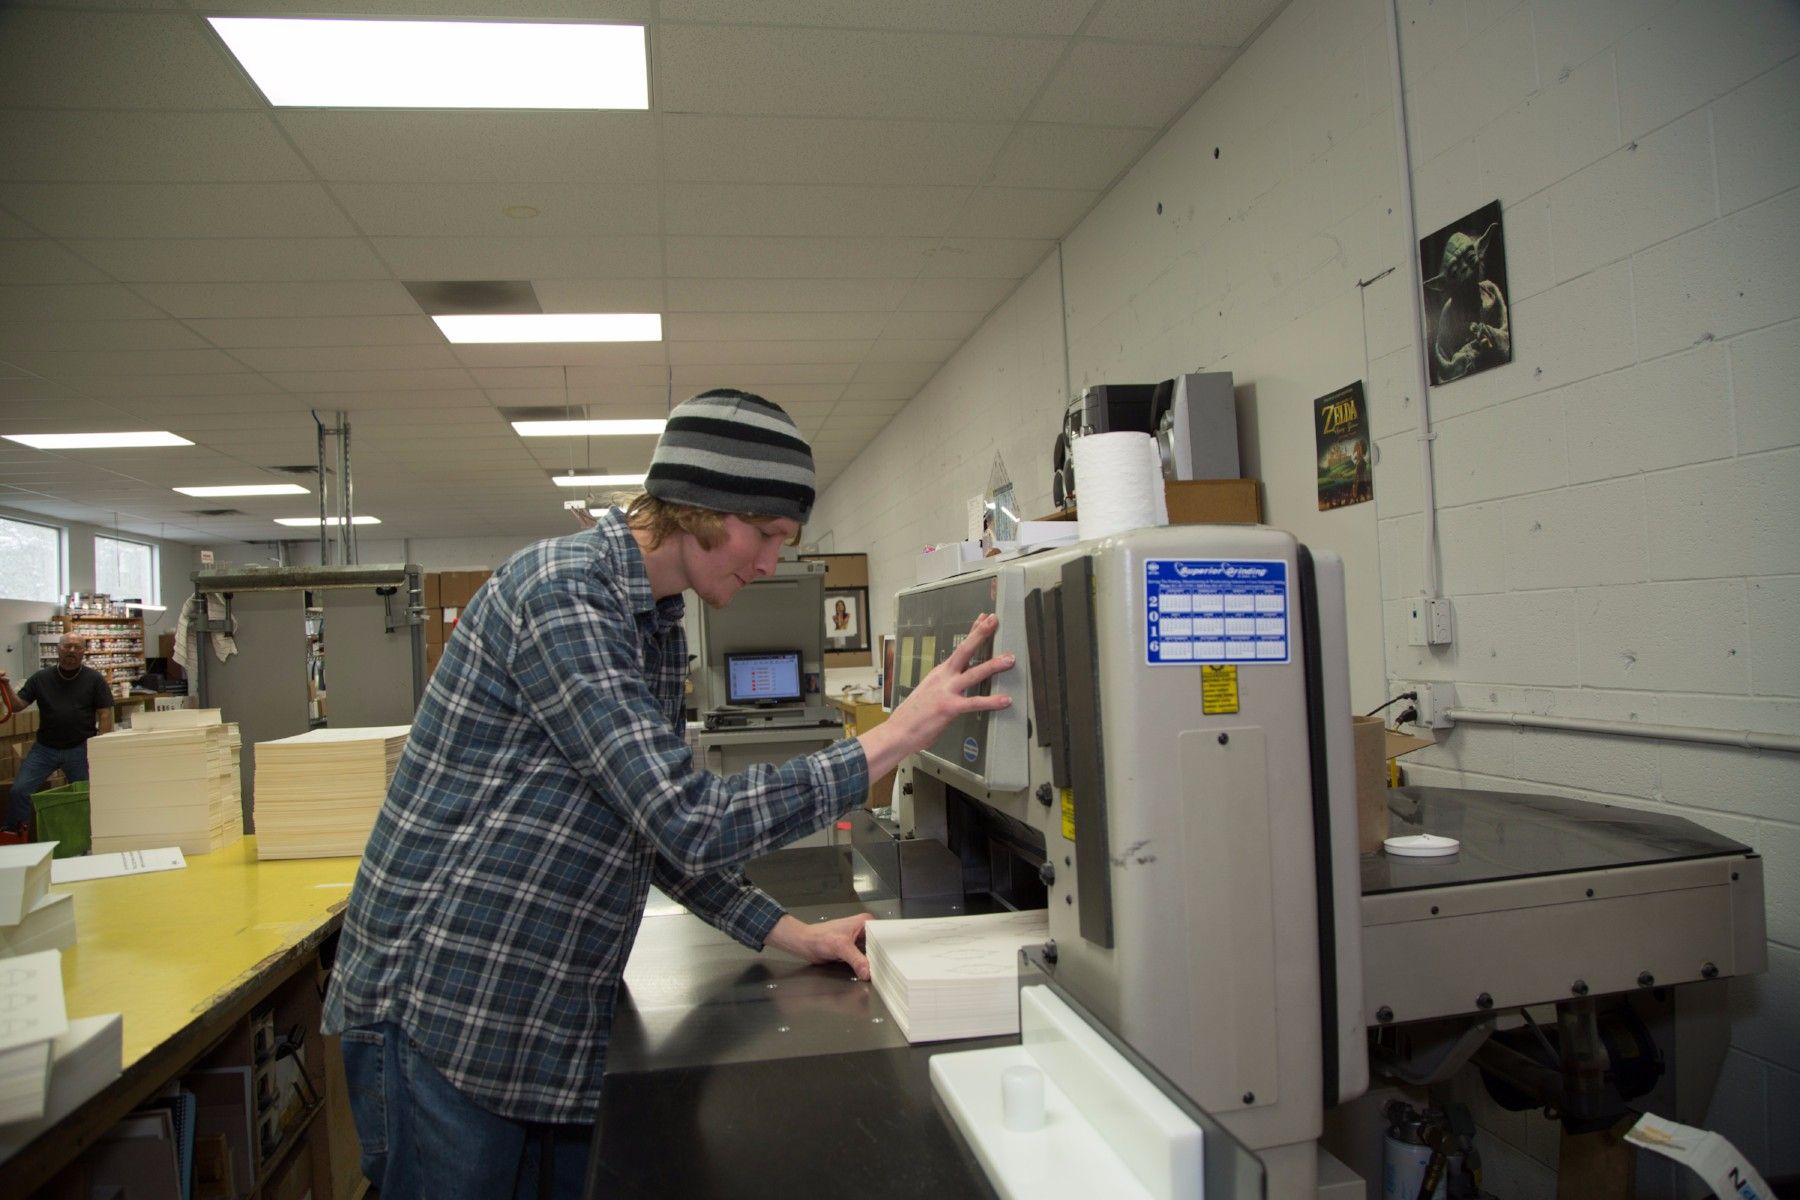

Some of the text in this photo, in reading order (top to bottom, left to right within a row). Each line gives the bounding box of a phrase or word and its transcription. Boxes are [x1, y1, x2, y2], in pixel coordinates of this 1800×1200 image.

[1322, 400, 1358, 434] ZELDA
[1177, 564, 1267, 577] Superior Grinding
